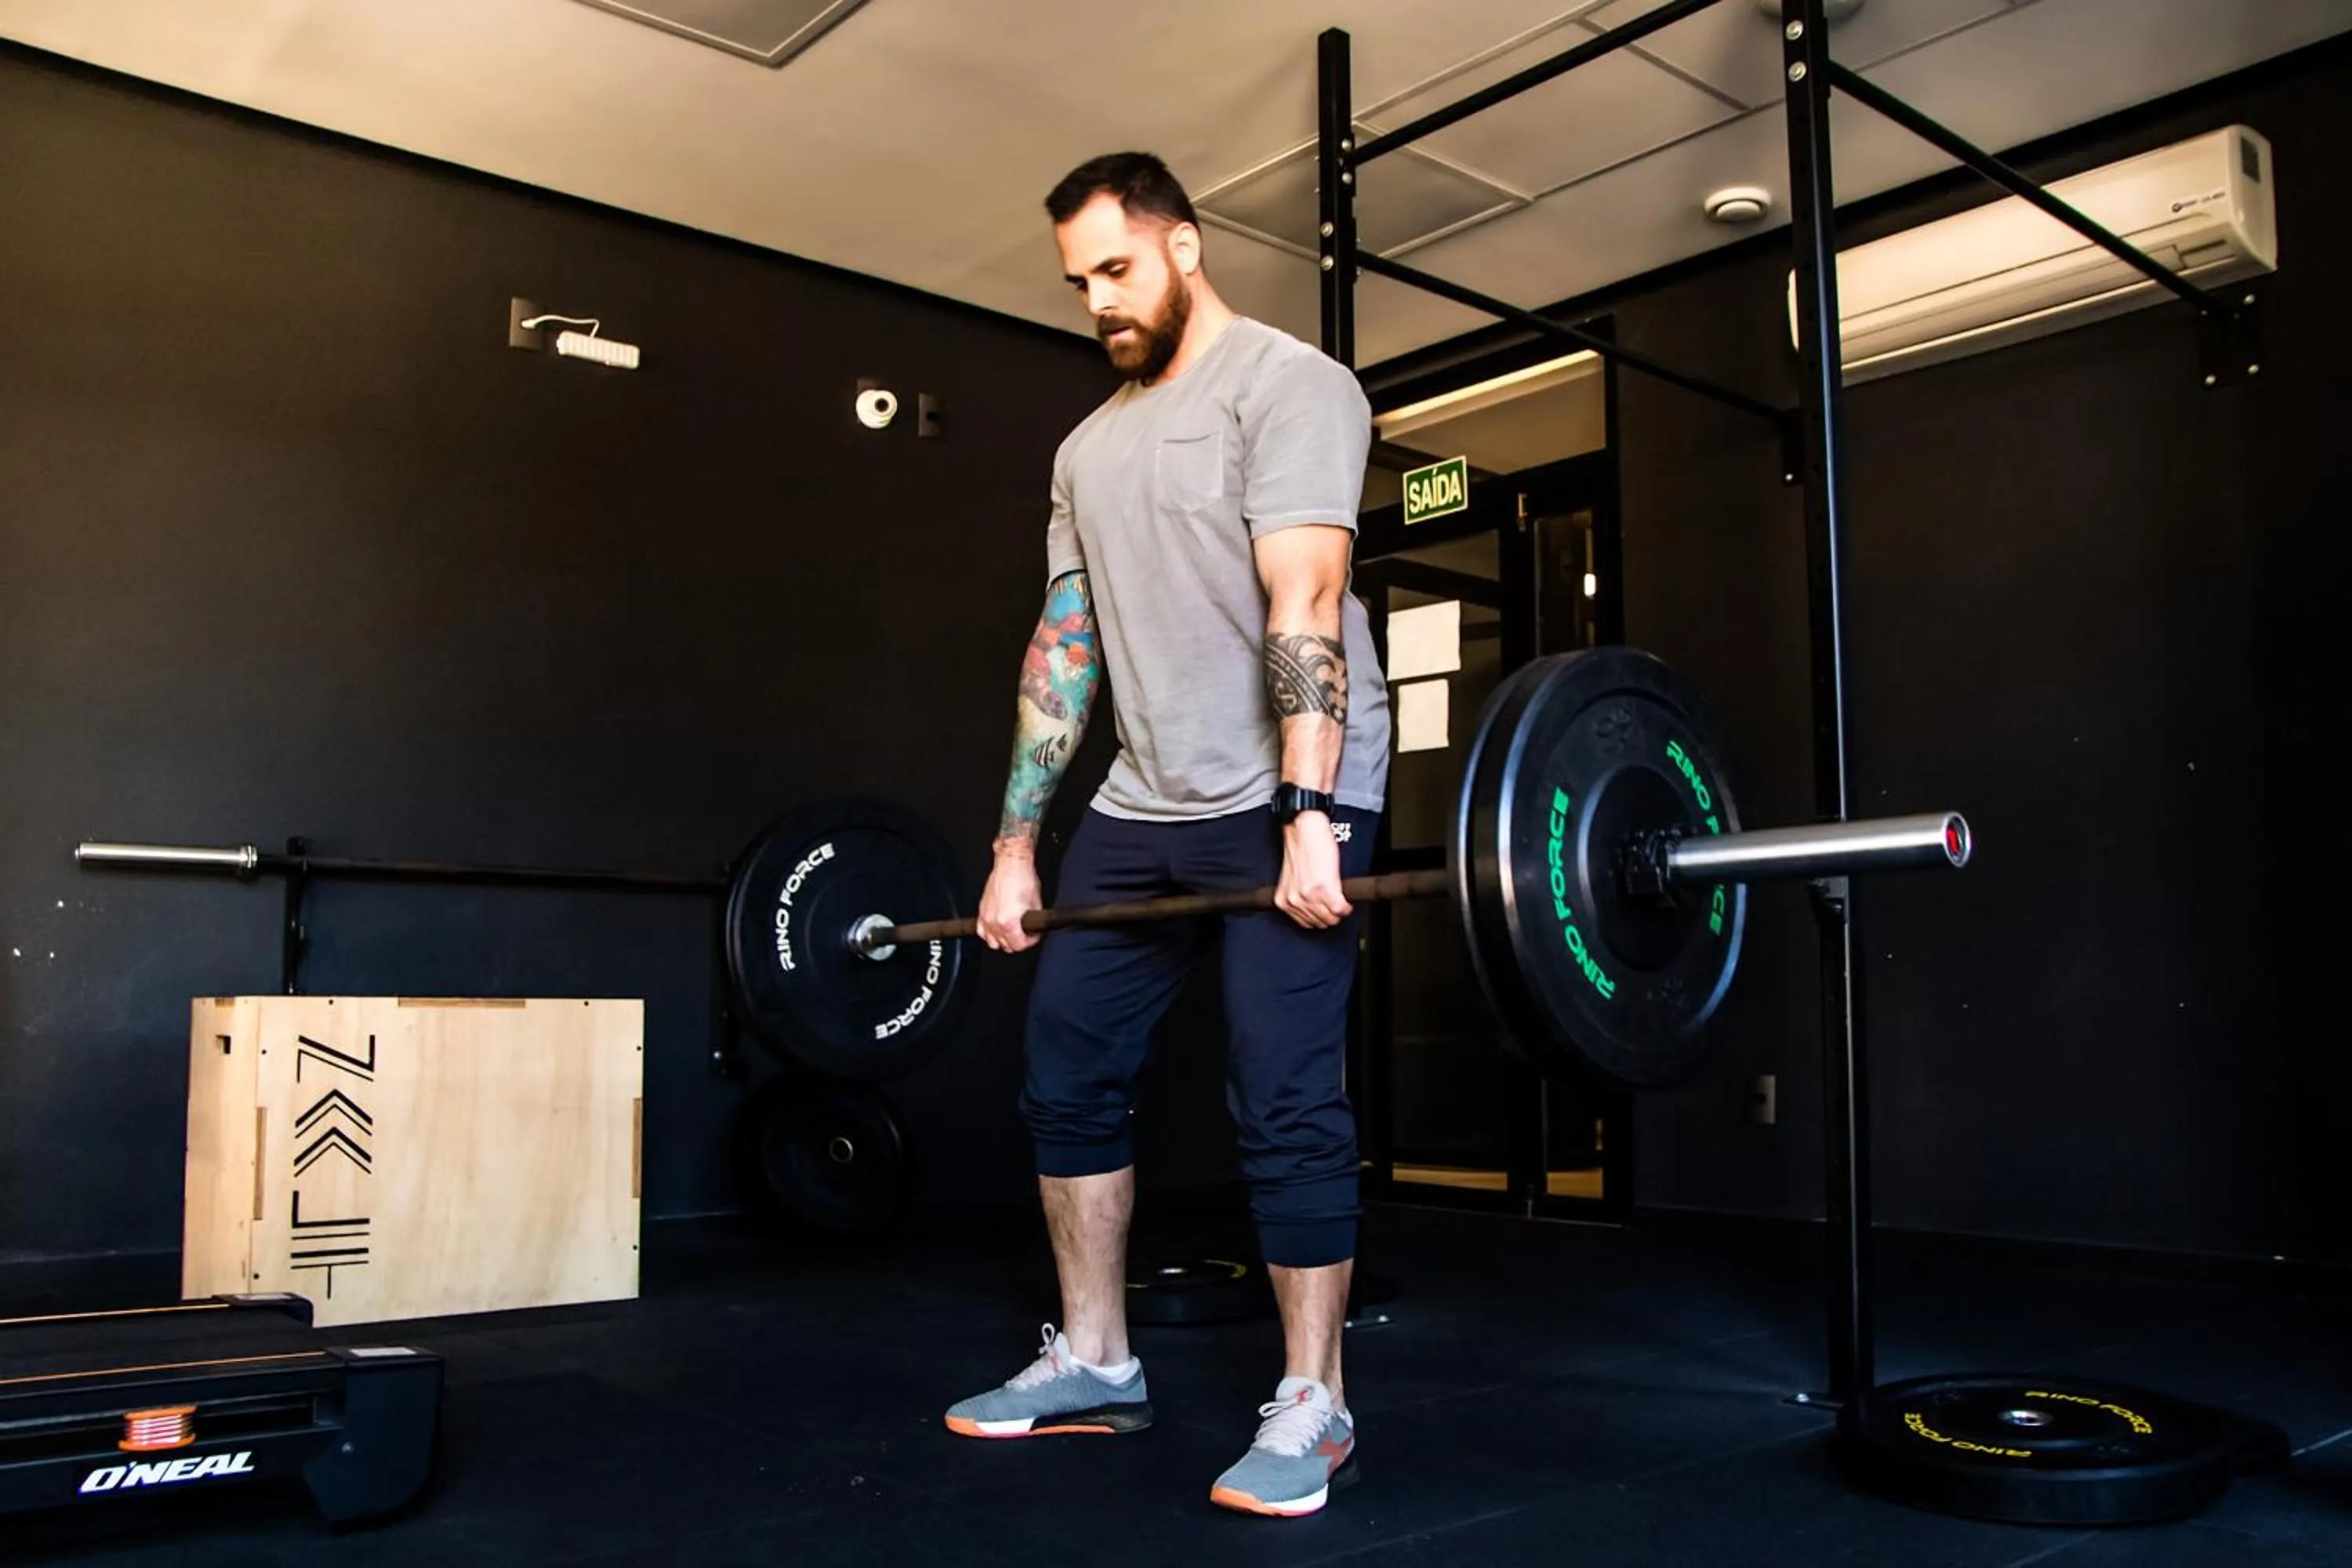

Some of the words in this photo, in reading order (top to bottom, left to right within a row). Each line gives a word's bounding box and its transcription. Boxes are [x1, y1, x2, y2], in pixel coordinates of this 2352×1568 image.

[1408, 466, 1462, 514] SAÍDA
[1666, 739, 1711, 811] RINO
[779, 843, 835, 906] FORCE
[1547, 786, 1572, 921] FORCE
[775, 908, 796, 971] RINO
[1563, 924, 1616, 1000] RINO
[874, 985, 933, 1040] FORCE
[79, 1451, 255, 1494] O'NEAL
